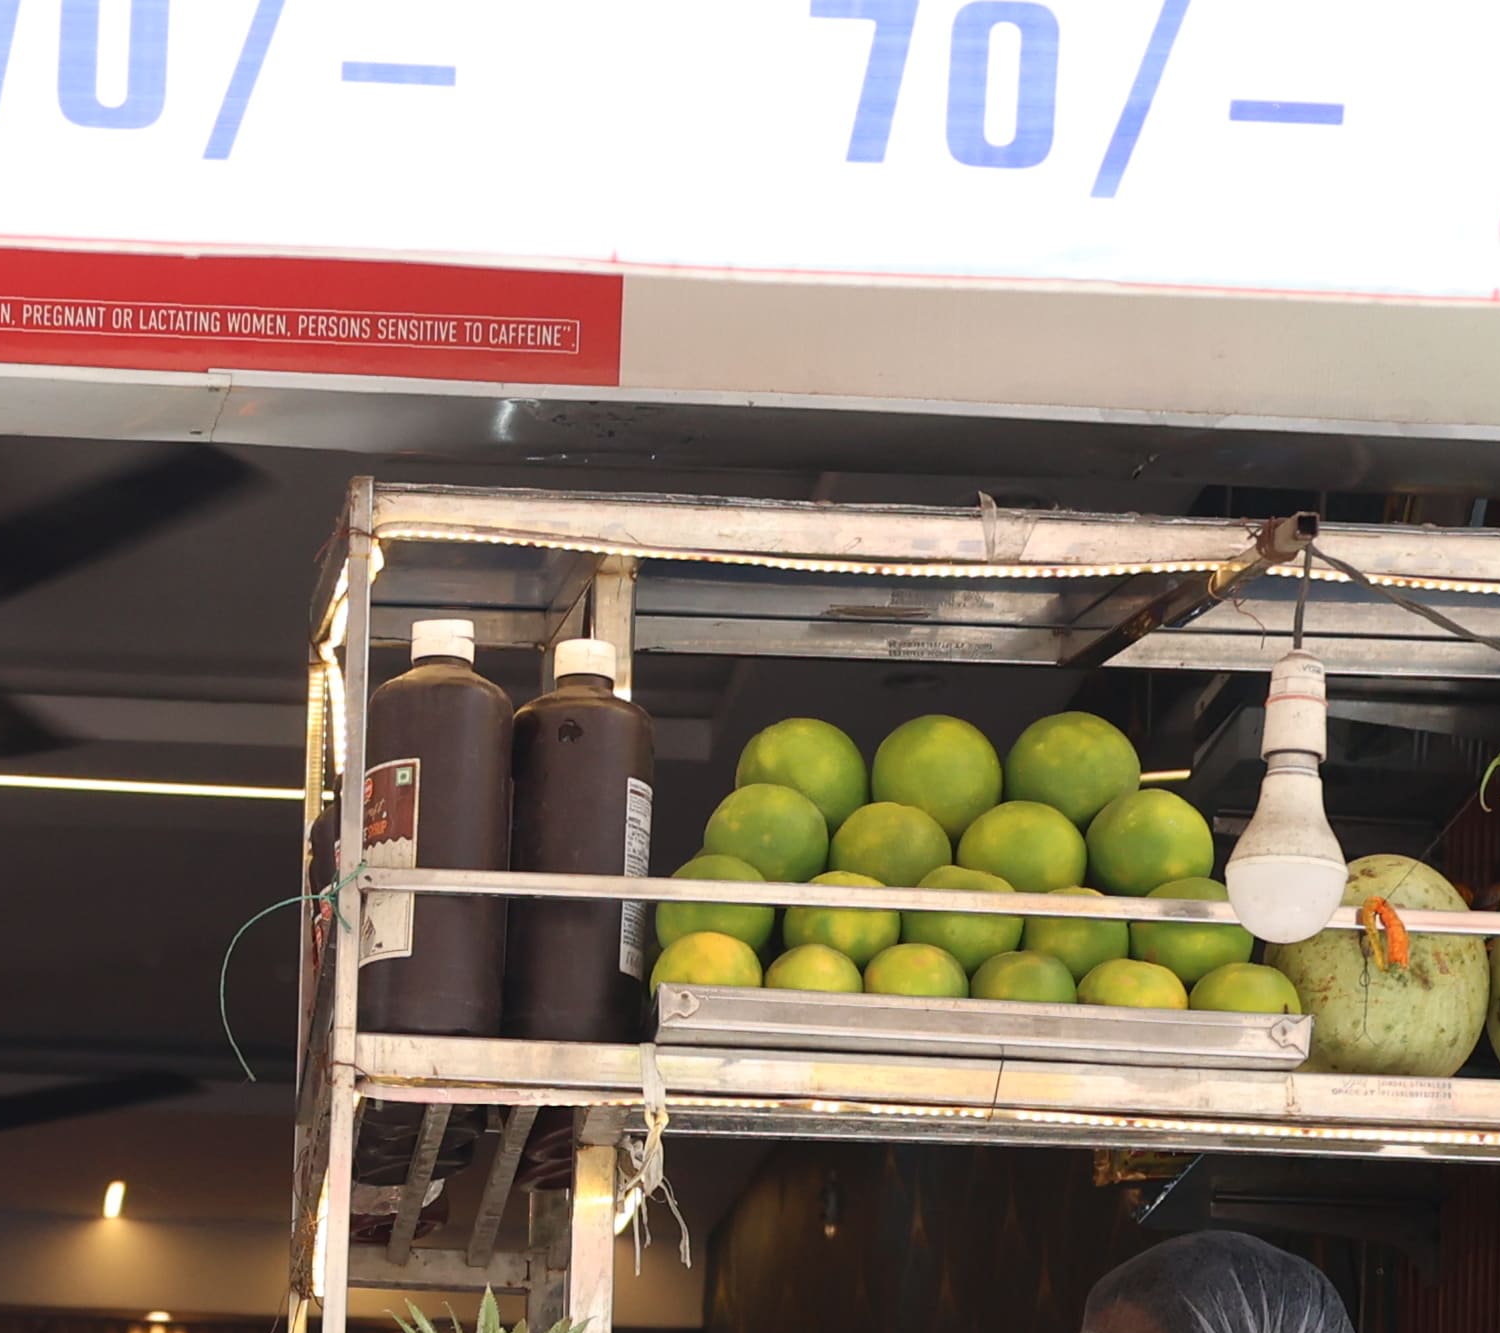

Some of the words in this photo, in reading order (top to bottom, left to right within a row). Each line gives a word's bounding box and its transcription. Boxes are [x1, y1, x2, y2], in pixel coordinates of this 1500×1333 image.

[811, 0, 1344, 198] 70/-
[22, 303, 106, 329] PREGNANT
[111, 307, 133, 330] OR
[139, 308, 221, 334] LACTATING
[298, 315, 371, 340] PERSONS
[377, 318, 457, 343] SENSITIVE
[463, 322, 483, 344] TO
